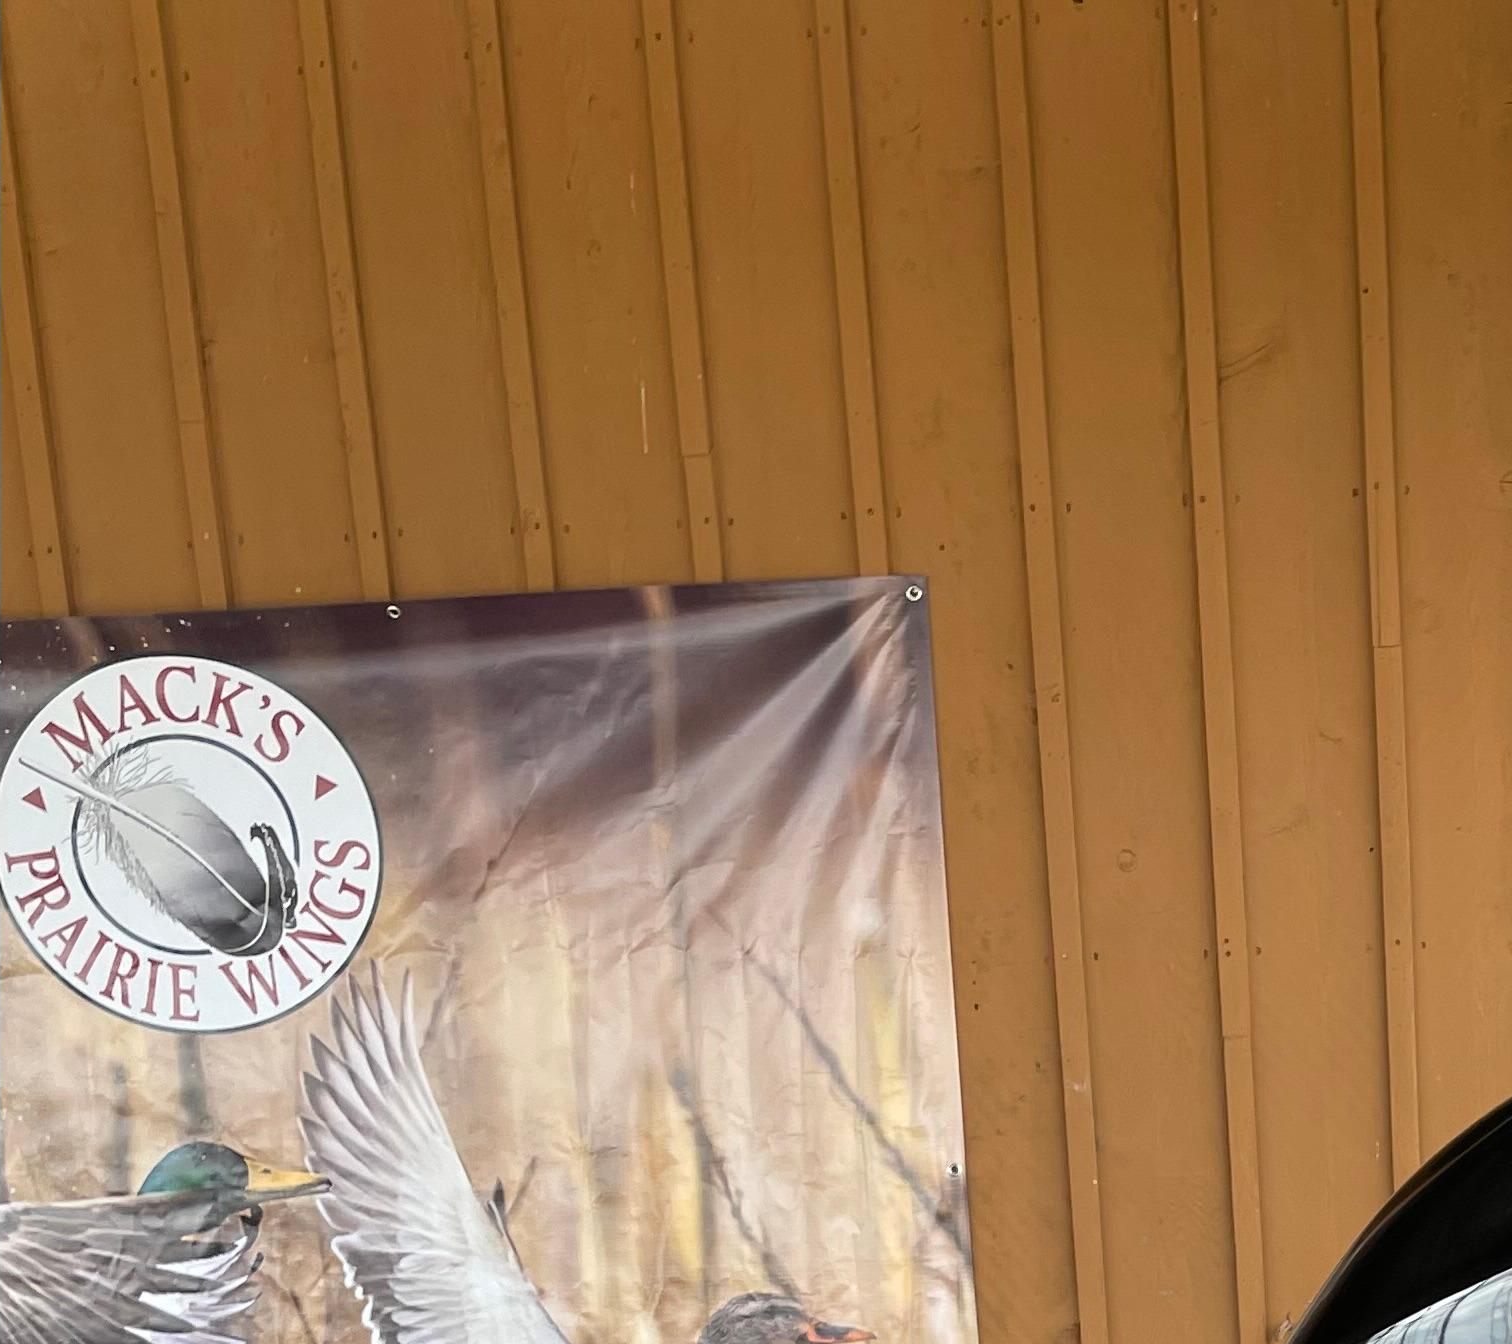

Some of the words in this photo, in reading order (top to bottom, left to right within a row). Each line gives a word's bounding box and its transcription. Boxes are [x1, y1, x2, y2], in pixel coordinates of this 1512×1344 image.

[41, 665, 305, 773] MACK'S
[4, 845, 201, 1023] PRAIRIE
[218, 838, 371, 1016] WINGS
